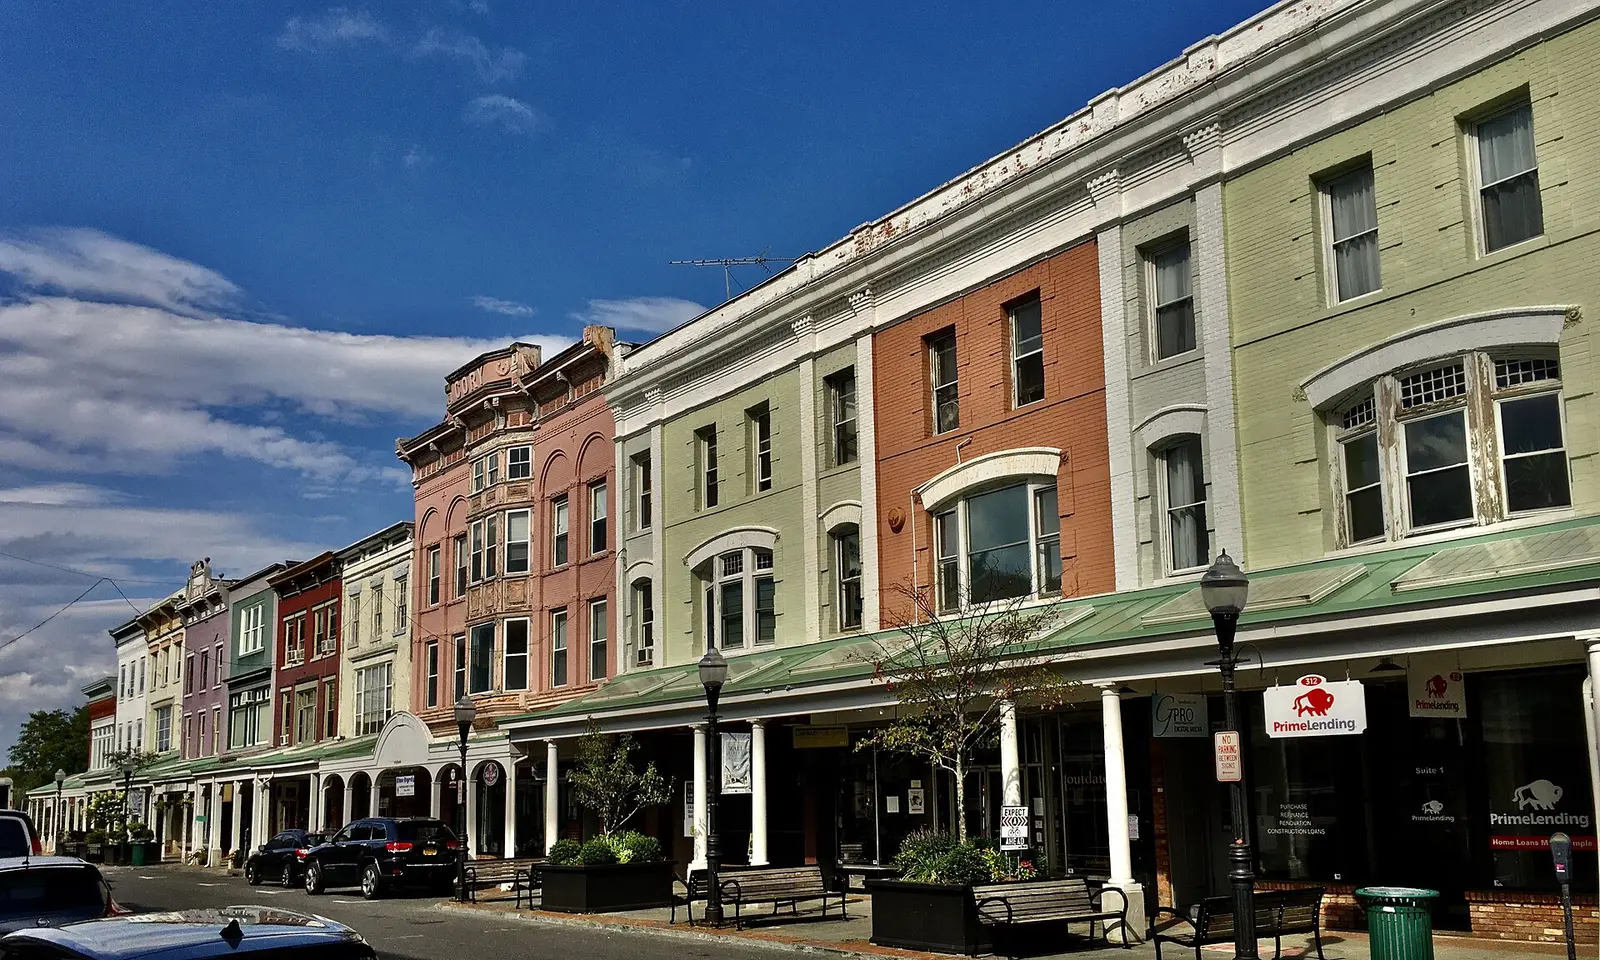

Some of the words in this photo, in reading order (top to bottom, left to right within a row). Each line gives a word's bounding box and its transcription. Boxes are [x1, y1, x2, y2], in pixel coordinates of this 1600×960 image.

[455, 365, 483, 399] CORY
[1415, 700, 1459, 712] PrimeLending
[1274, 718, 1355, 732] PrimeLending
[1222, 735, 1231, 744] NO
[1218, 745, 1237, 754] PARKING
[1415, 766, 1437, 774] Suite
[1005, 809, 1026, 817] EXPECT
[1490, 813, 1589, 828] PrimeLending
[1005, 837, 1025, 845] AHEAD
[1492, 838, 1514, 846] Home
